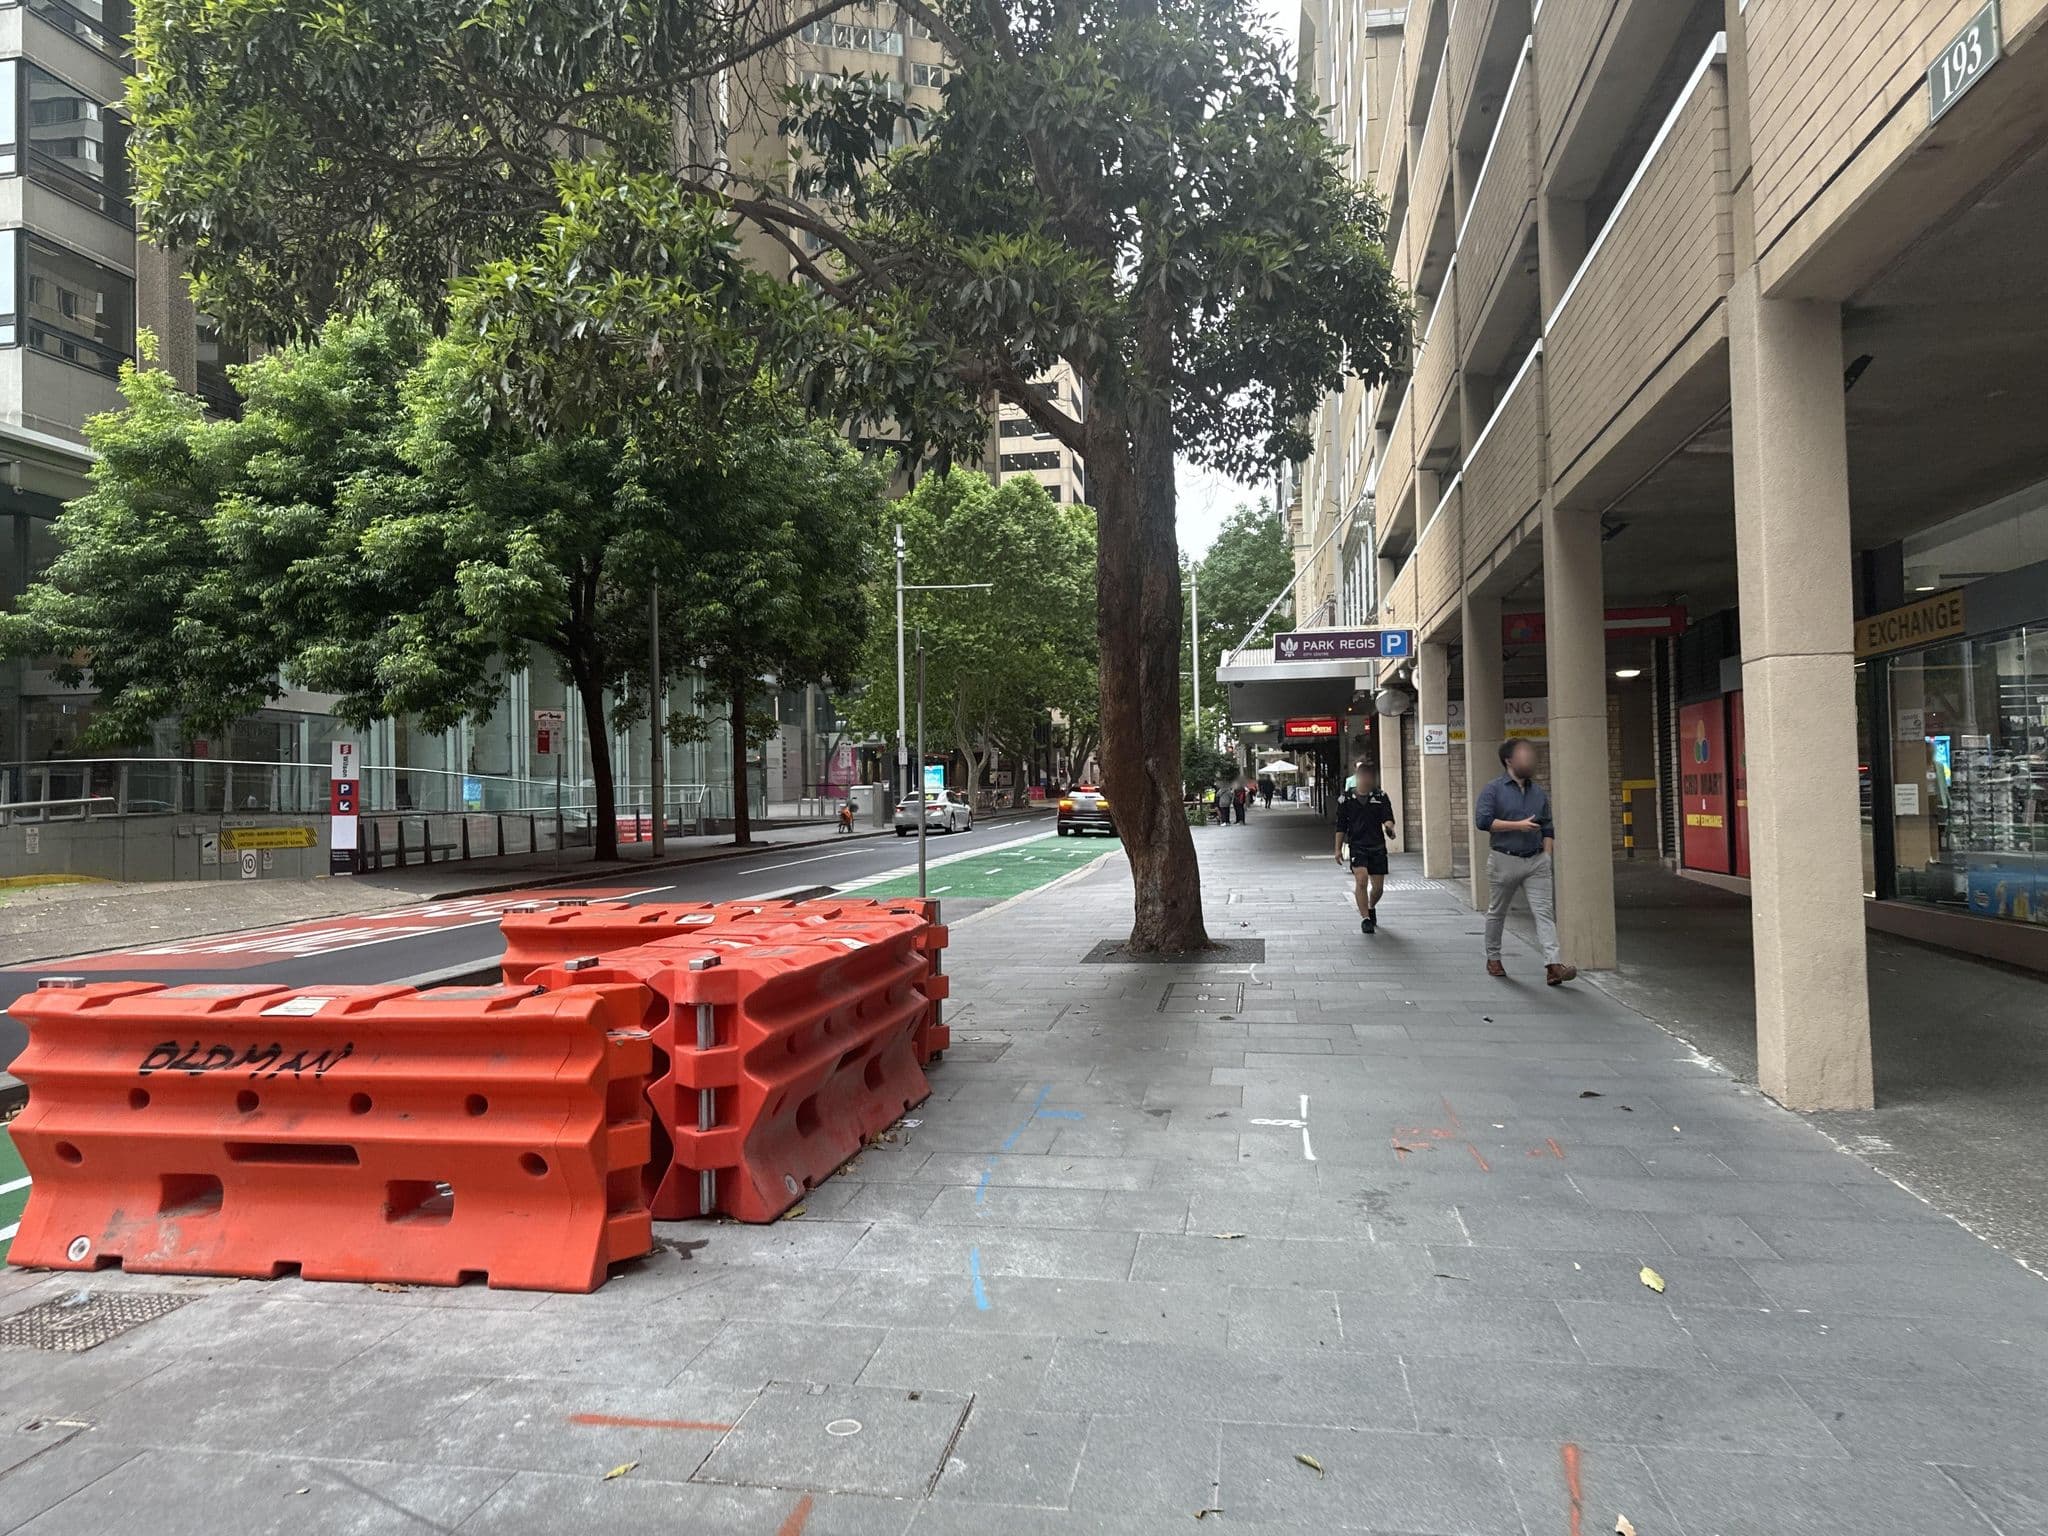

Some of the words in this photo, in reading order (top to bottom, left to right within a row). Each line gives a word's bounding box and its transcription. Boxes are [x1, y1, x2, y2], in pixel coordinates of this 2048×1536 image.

[1941, 26, 1982, 103] 193
[1868, 598, 1961, 648] EXCHANGE
[1303, 640, 1334, 650] PARK
[1340, 638, 1375, 649] REGIS
[1387, 634, 1401, 653] P
[340, 784, 350, 794] P
[244, 858, 254, 869] 10
